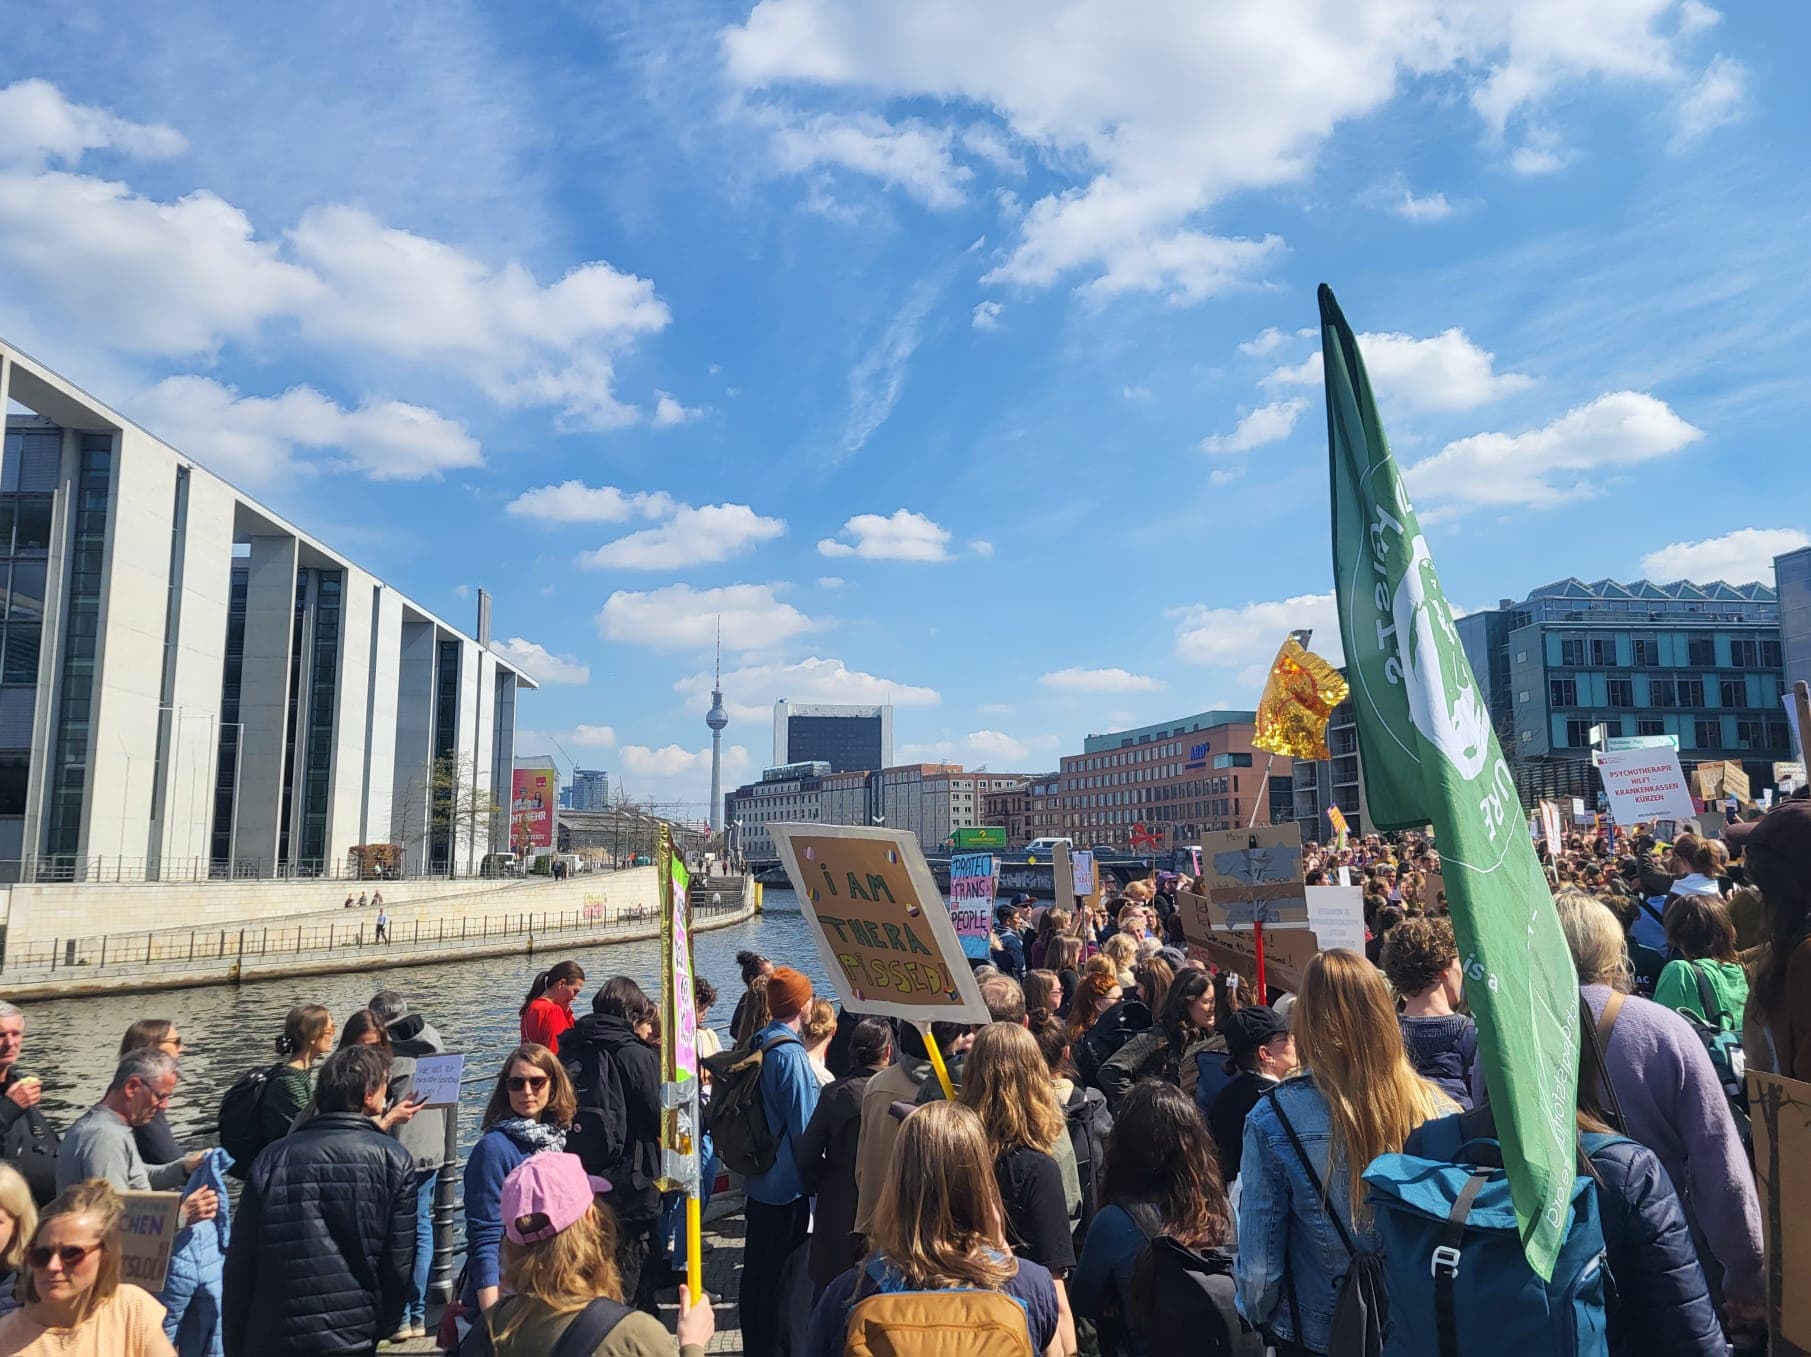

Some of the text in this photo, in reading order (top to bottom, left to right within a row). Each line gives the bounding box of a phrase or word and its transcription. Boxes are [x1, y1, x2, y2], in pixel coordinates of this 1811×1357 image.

[1609, 764, 1673, 778] PSYCHOTHERAPIE
[1631, 776, 1650, 785] HILFT
[1614, 782, 1680, 796] KRANKENKASSEN
[1634, 793, 1664, 803] KÜRZEN
[952, 855, 992, 881] PROTECT
[846, 871, 896, 904] AM
[952, 880, 985, 900] TRANS
[951, 910, 986, 931] PEOPLE
[817, 915, 932, 956] THERA
[1463, 952, 1485, 981] is
[119, 1213, 164, 1235] CHEN
